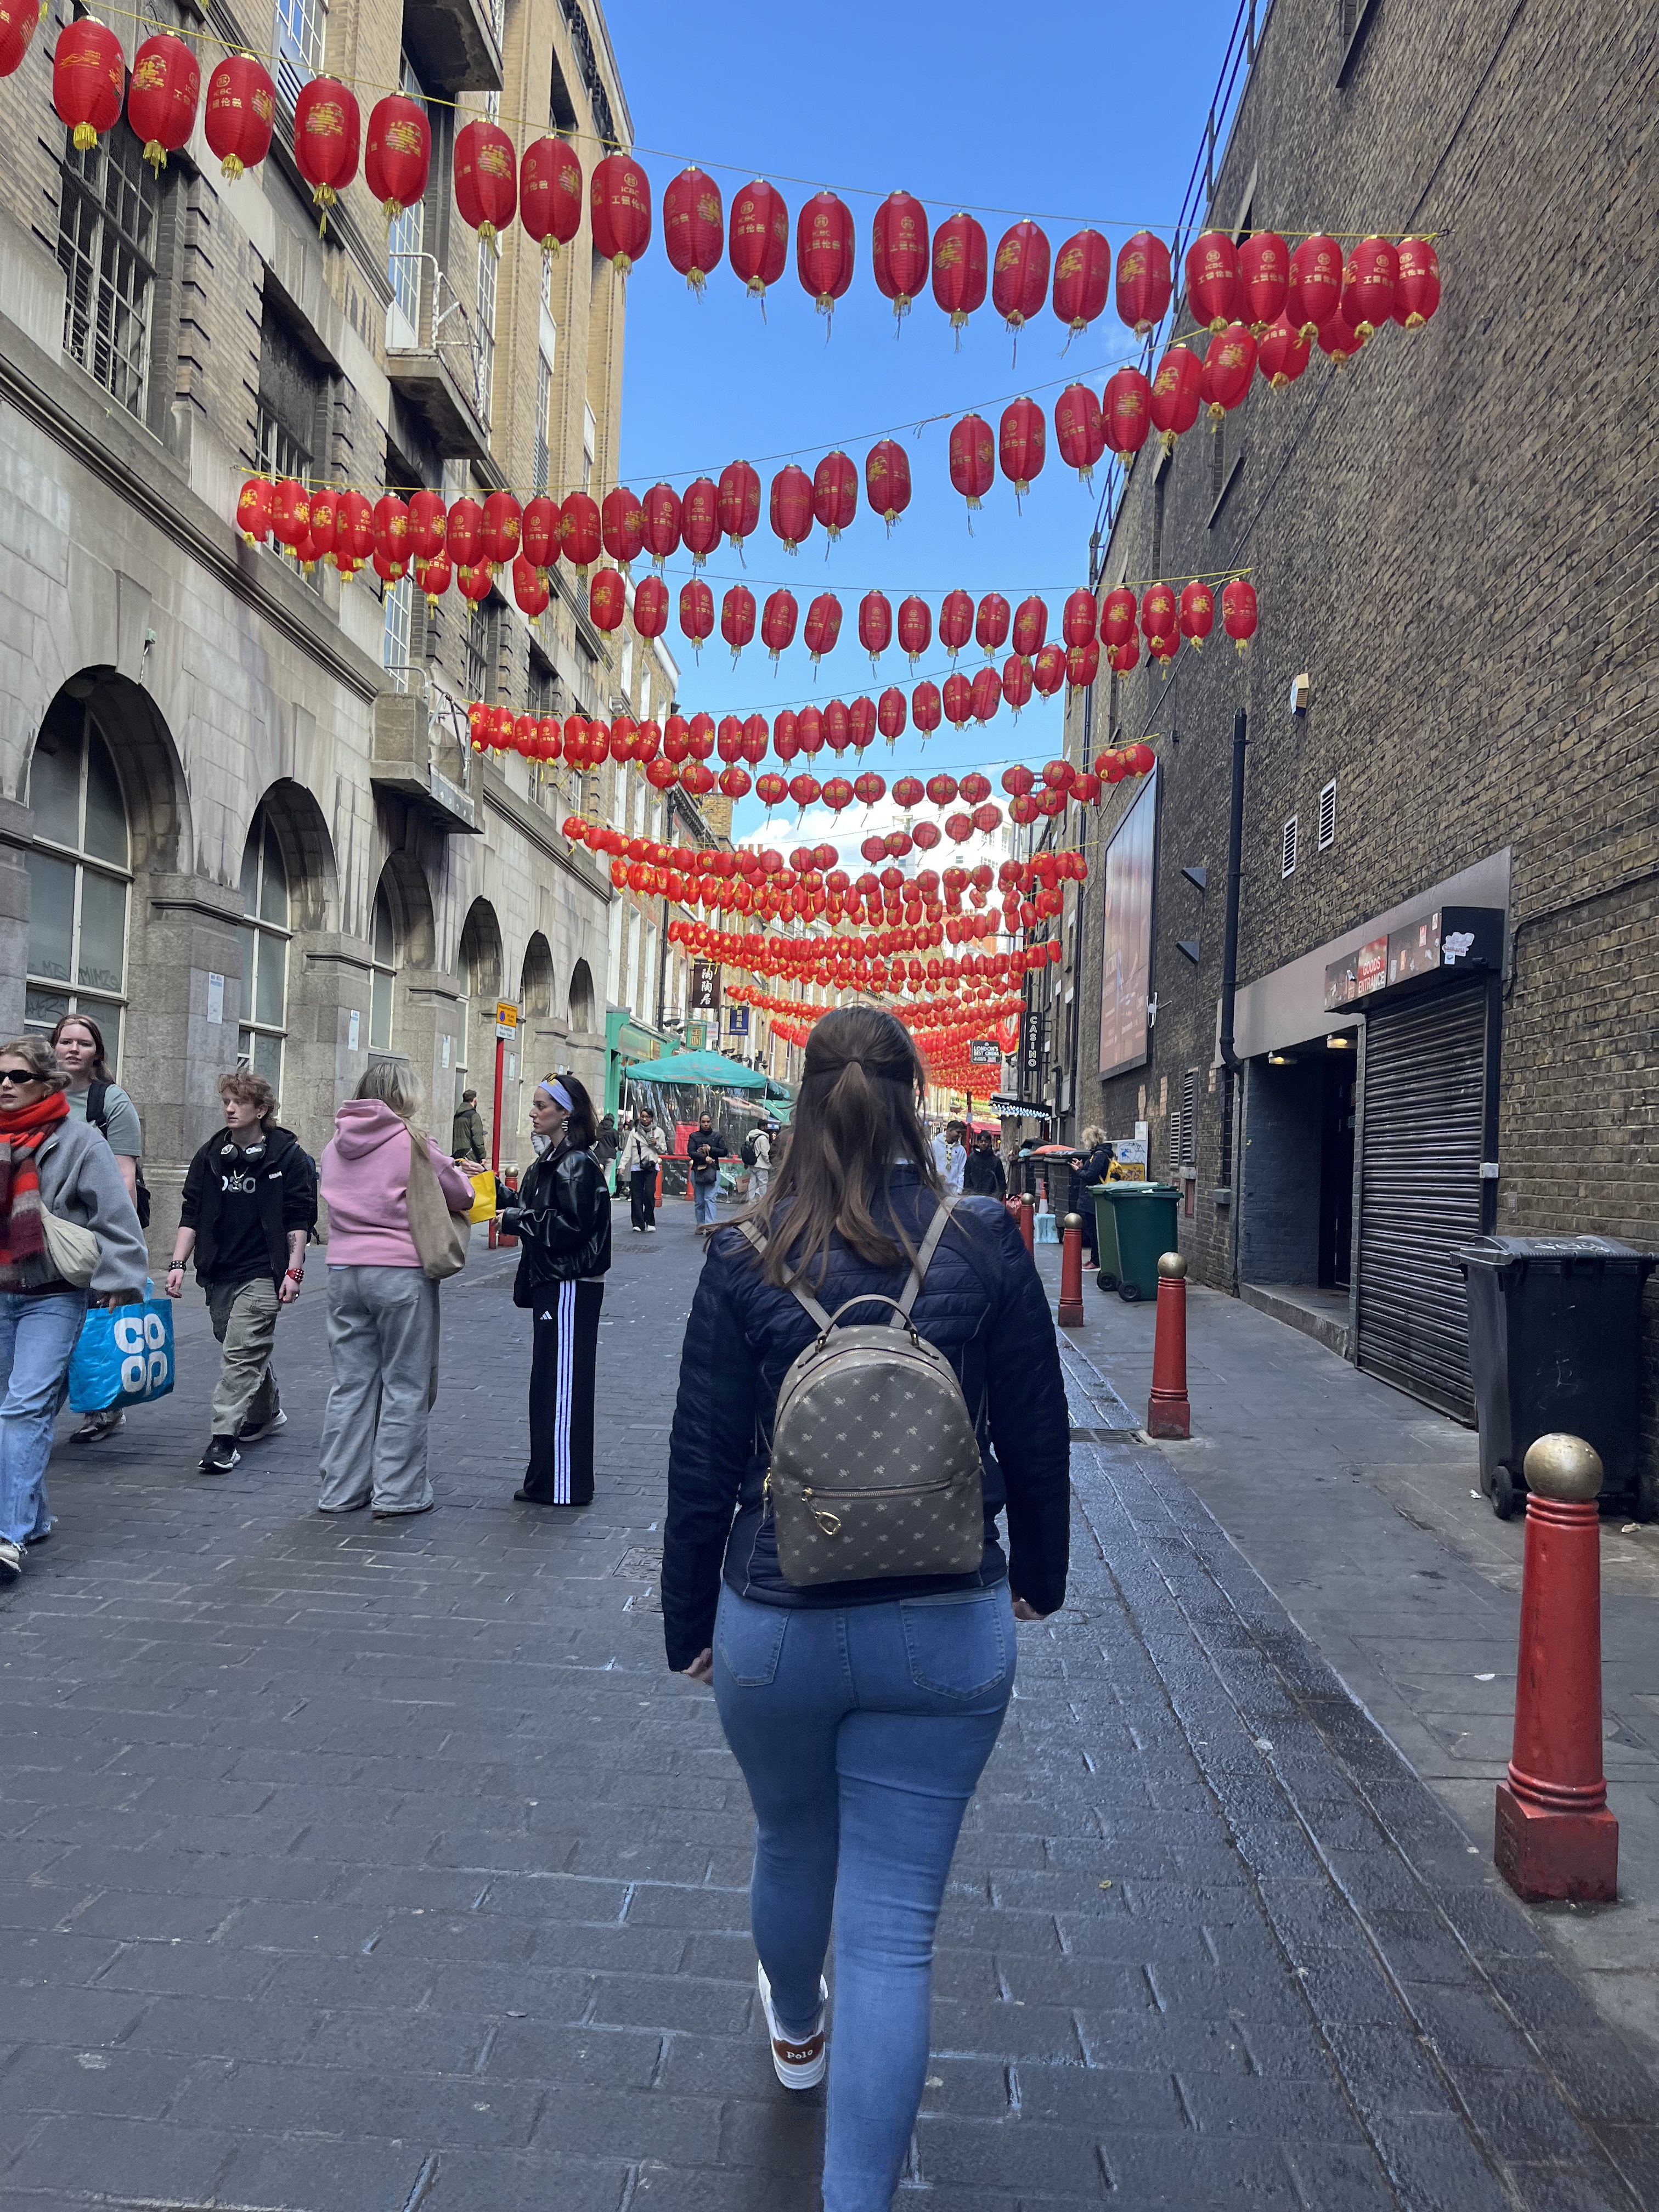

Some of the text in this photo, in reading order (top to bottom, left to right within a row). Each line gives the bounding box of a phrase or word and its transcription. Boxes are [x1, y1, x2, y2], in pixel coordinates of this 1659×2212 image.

[1362, 956, 1381, 977] GOODS
[700, 968, 713, 1005] 陶陶居
[1358, 970, 1385, 994] ENTRANCE
[1028, 1016, 1038, 1067] CASINO
[114, 1313, 166, 1354] CO
[786, 2049, 813, 2059] Polo
